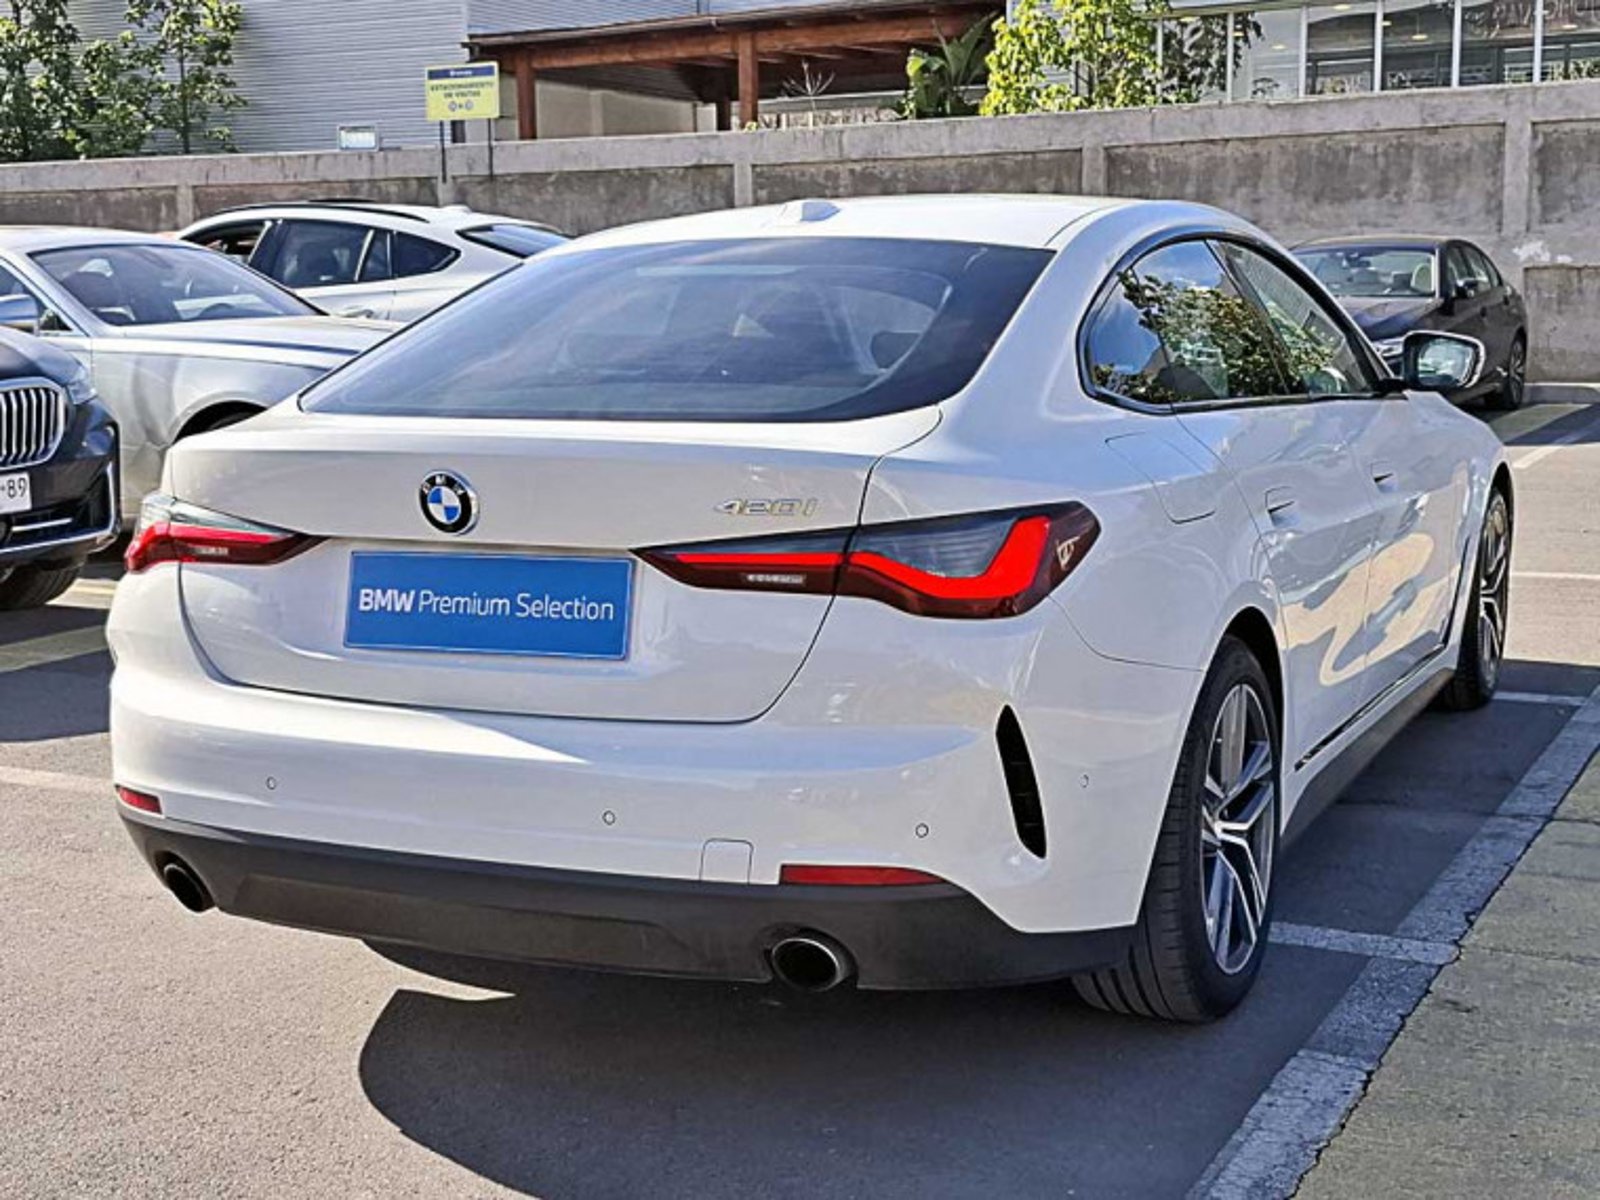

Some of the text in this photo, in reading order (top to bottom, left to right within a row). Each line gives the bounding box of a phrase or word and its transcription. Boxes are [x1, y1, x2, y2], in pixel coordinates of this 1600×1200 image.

[713, 497, 819, 517] 420i
[358, 588, 615, 621] BMW Premium Selection
